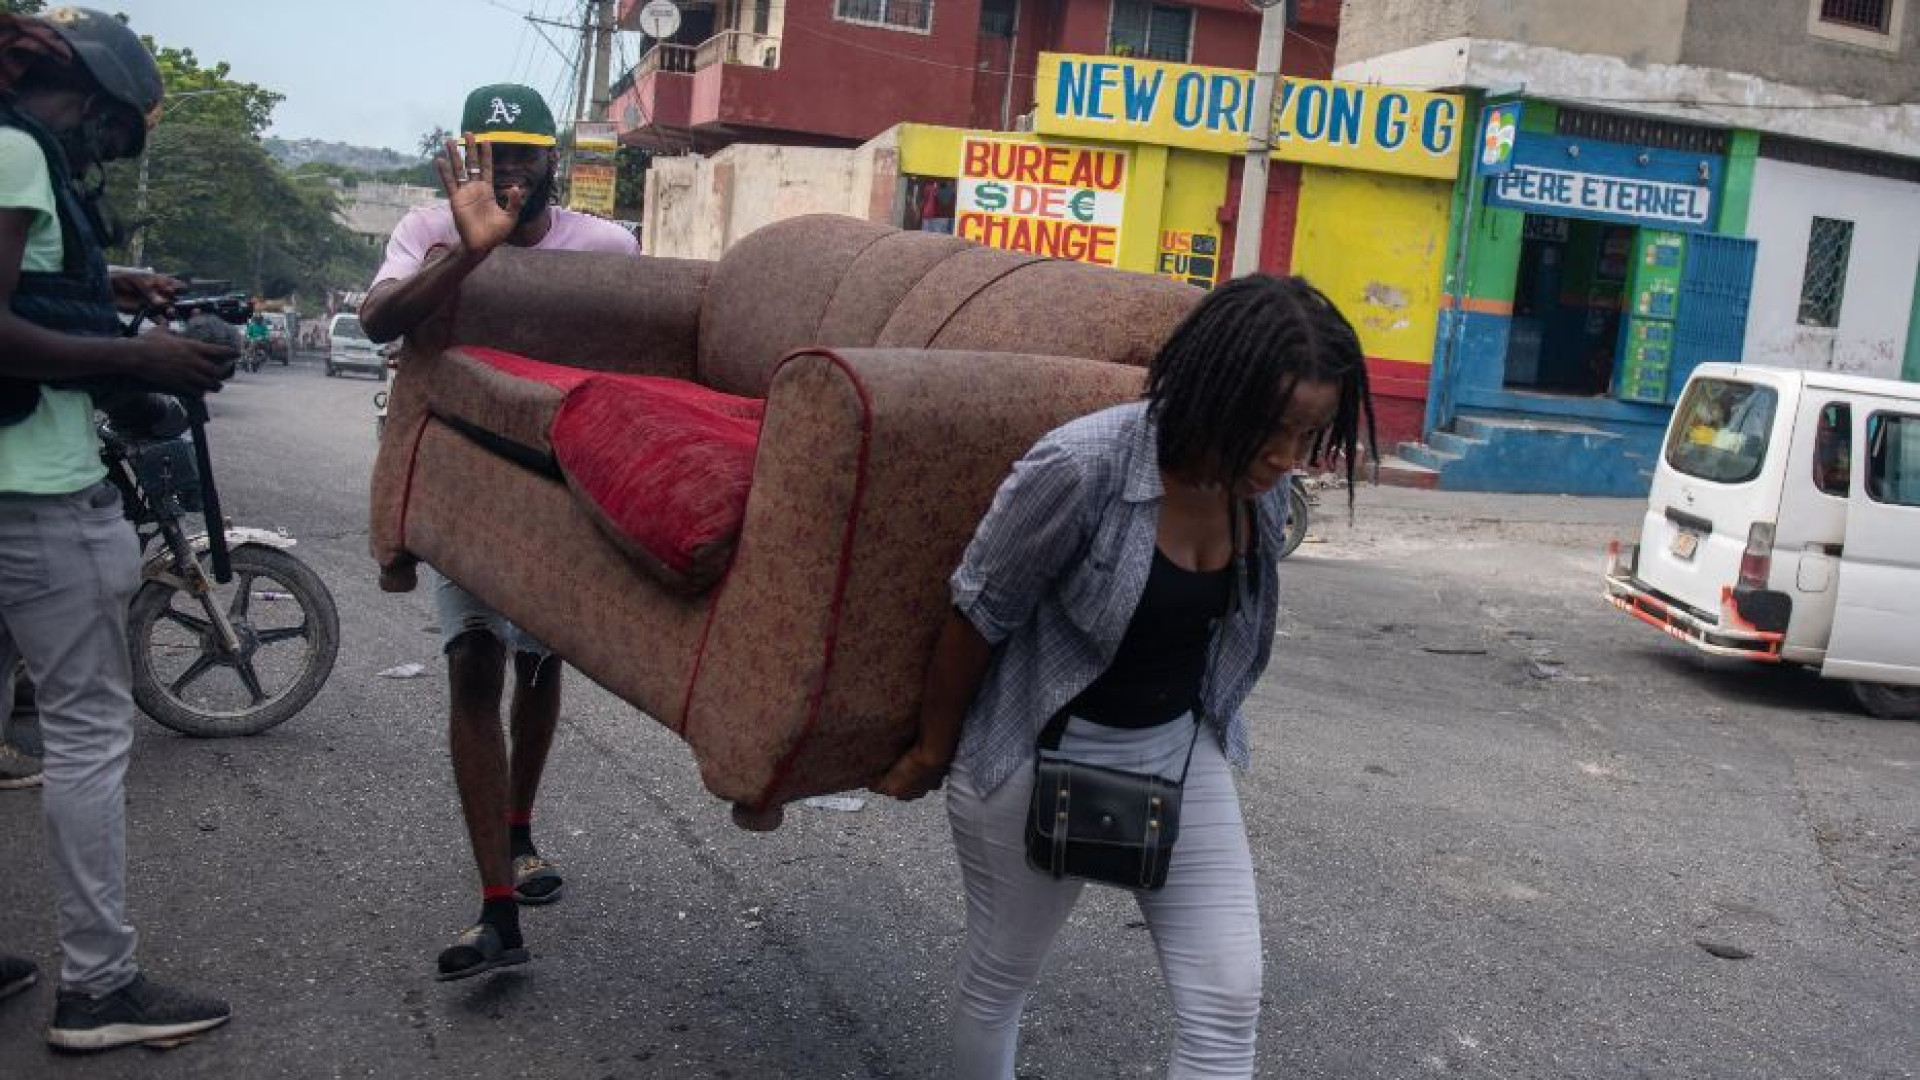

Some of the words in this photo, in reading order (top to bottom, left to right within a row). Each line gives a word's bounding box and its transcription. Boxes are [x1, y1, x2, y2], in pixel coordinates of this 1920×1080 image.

[1055, 60, 1164, 122] NEW
[964, 140, 1124, 190] BUREAU
[1012, 184, 1066, 218] DE
[1502, 169, 1574, 203] PERE
[1581, 177, 1702, 219] ETERNEL
[957, 213, 1117, 264] CHANGE
